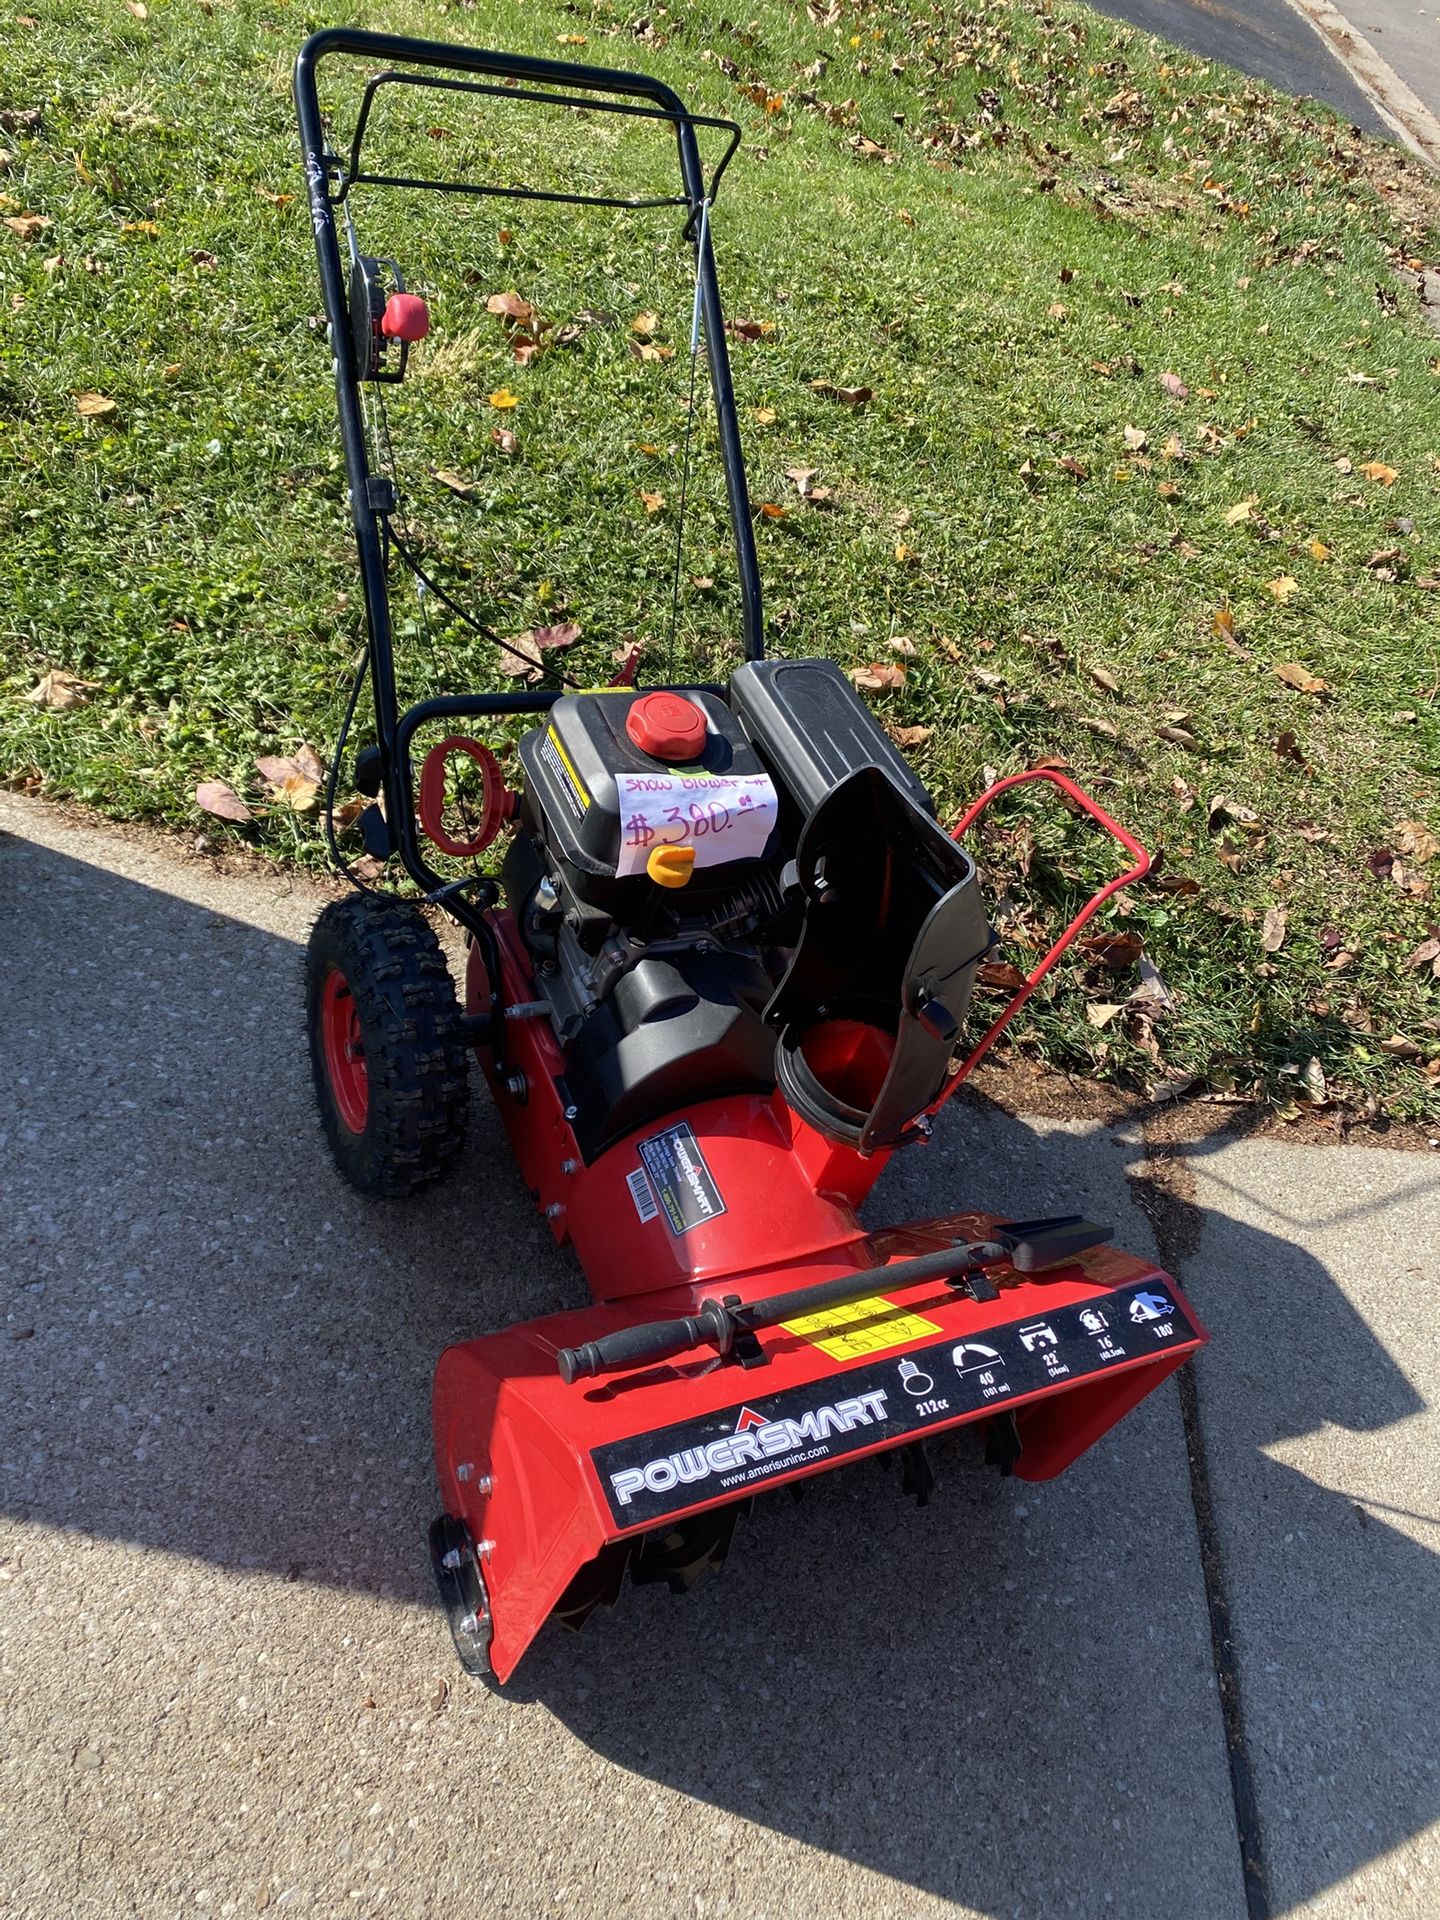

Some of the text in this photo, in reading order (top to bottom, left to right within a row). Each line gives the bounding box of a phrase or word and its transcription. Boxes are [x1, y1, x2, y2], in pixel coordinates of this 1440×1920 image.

[669, 1131, 714, 1215] POWERSMART
[915, 1398, 950, 1417] 212cc
[609, 1389, 889, 1505] POWERSMART
[720, 1444, 830, 1488] www.amerisuninc.com
